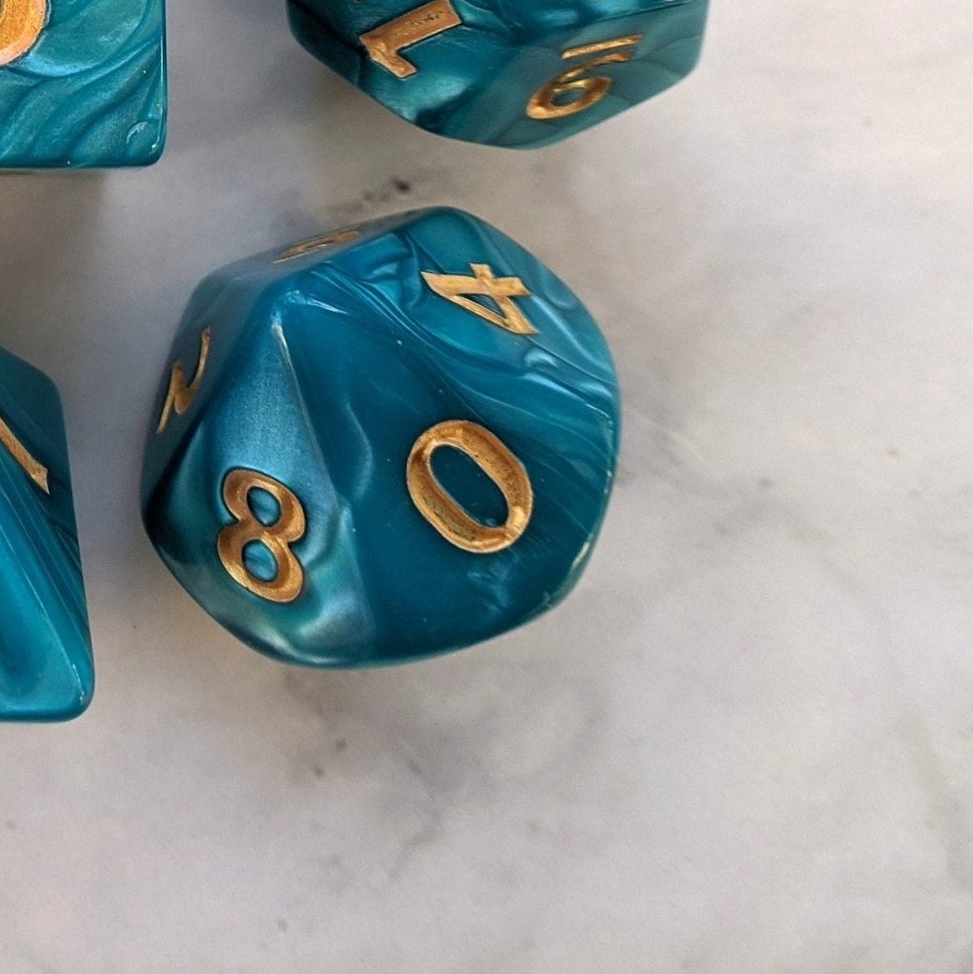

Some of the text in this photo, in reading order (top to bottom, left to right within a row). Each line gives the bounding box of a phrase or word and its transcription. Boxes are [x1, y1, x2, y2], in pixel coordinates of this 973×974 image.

[421, 262, 539, 335] 4
[218, 470, 307, 603] 8
[406, 420, 534, 554] 0
